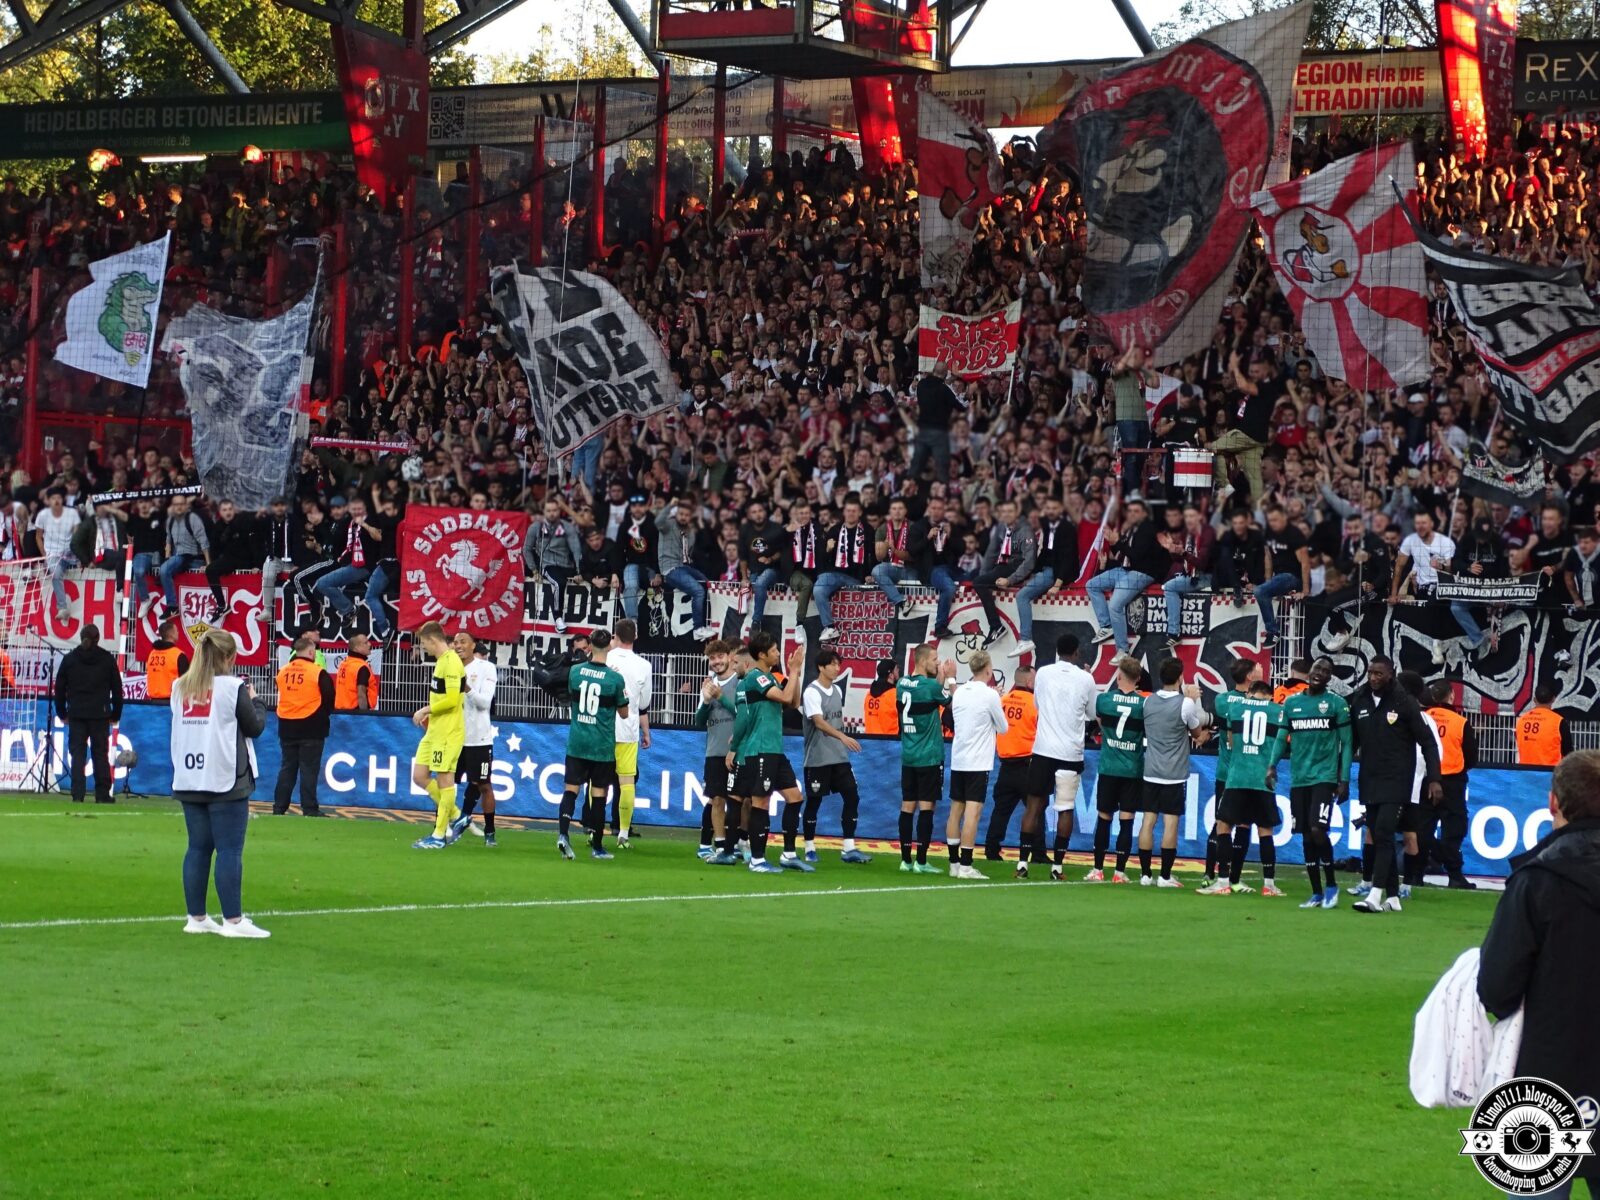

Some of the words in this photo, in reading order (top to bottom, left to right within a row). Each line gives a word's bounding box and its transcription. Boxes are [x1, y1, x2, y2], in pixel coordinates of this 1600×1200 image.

[1297, 62, 1362, 86] EGION
[1366, 64, 1395, 83] FÜR
[1399, 66, 1425, 82] DIE
[1294, 86, 1425, 112] LTRADITION
[1525, 89, 1600, 103] CAPITAL
[24, 106, 157, 133] HEIDELBERGER
[161, 102, 324, 128] BETONELEMENTE
[551, 369, 665, 449] UTTGART
[406, 569, 525, 630] STUTTGART
[1437, 585, 1504, 598] VERSTORBENEN
[1504, 587, 1536, 598] ULTRAS
[831, 602, 895, 619] ERBANNTE
[1182, 598, 1206, 611] IST
[1147, 608, 1205, 624] IMER
[1146, 622, 1168, 633] BEI
[1181, 624, 1205, 635] NS!
[833, 645, 893, 660] URÜCK
[284, 672, 304, 685] 115
[578, 680, 602, 716] 16
[868, 698, 880, 710] 66
[1112, 693, 1140, 705] STUTTGART
[901, 691, 914, 724] 2
[1114, 705, 1132, 739] 7
[1241, 709, 1267, 746] 10
[1291, 718, 1330, 730] WINAMAX
[1523, 721, 1540, 734] 98
[184, 752, 205, 770] 09
[432, 750, 443, 764] 33
[1319, 802, 1330, 819] 14
